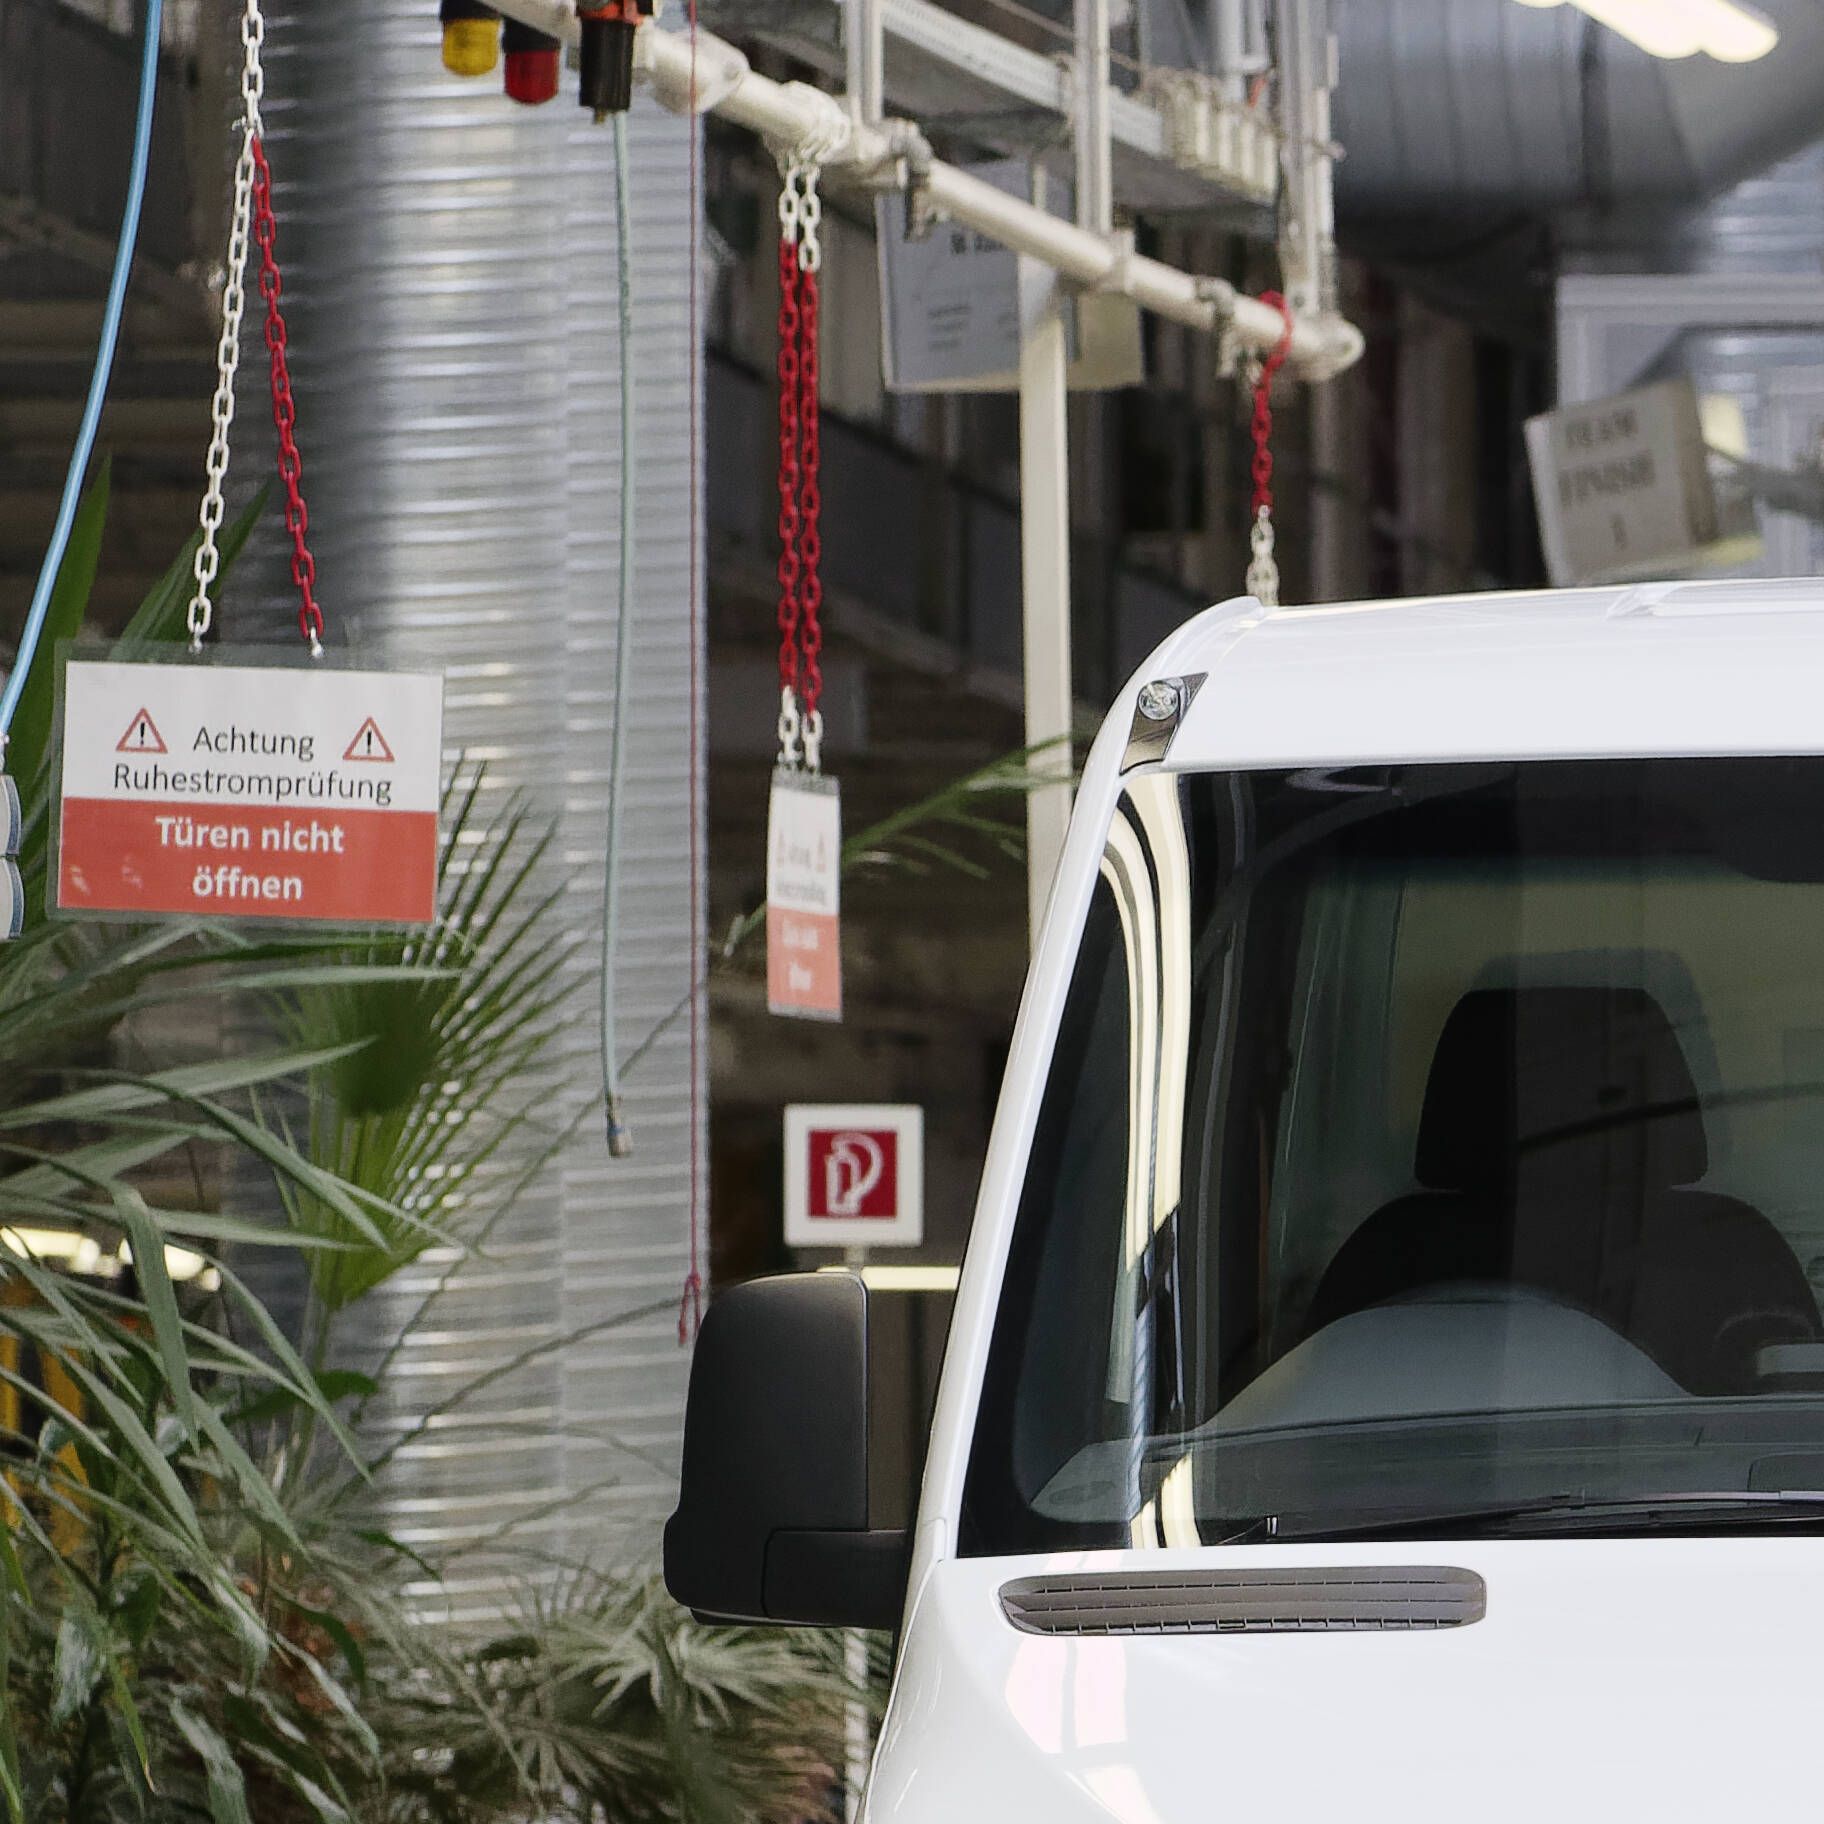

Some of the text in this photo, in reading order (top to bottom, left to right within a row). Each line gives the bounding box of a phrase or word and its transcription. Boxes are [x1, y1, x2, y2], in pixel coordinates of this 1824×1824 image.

[193, 725, 315, 762] Achtung
[113, 763, 393, 807] Ruhestromprüfung
[155, 815, 345, 853] Türen nicht
[192, 864, 304, 900] öffnen
